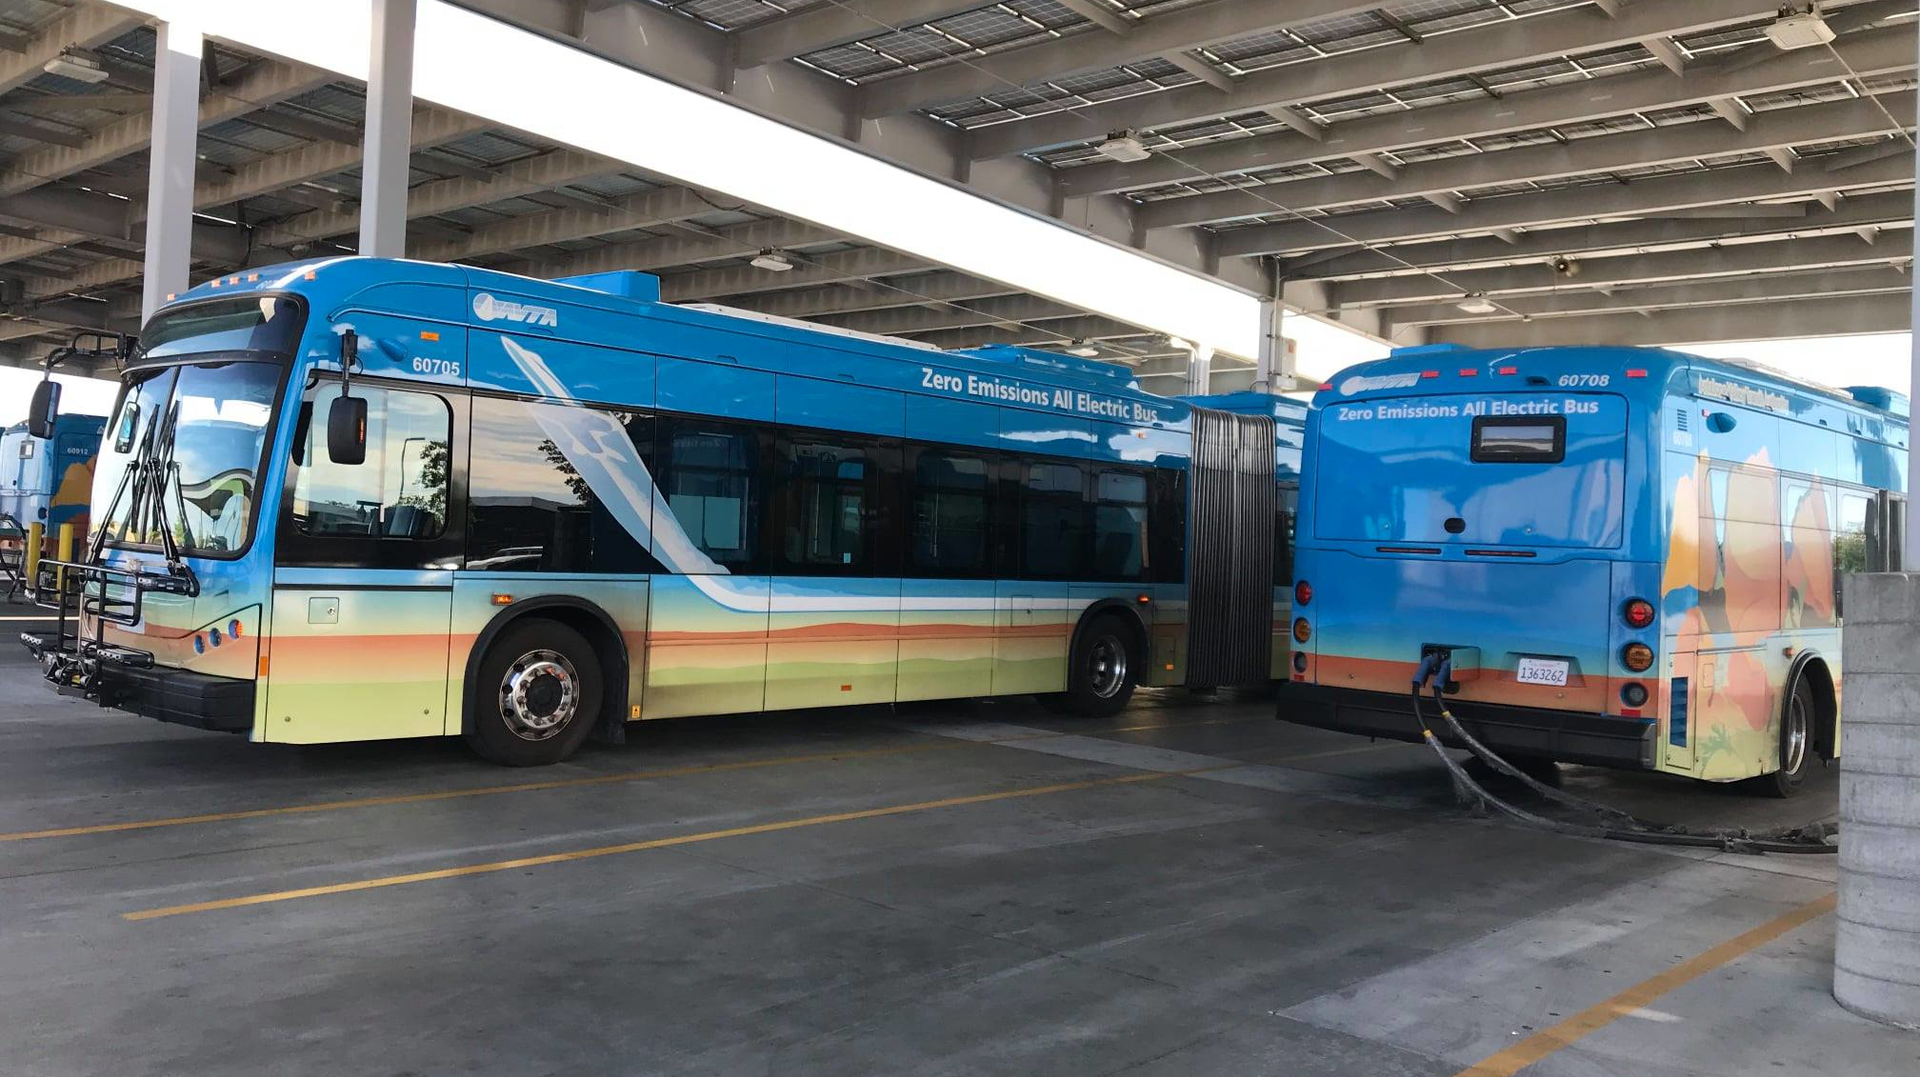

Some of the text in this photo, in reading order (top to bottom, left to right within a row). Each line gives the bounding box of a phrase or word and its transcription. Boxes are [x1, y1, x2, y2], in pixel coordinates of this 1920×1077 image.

[412, 357, 460, 376] 60705
[1557, 374, 1610, 387] 60708
[922, 367, 1159, 422] Zero Emissions All Electric Bus
[1338, 399, 1600, 421] Zero Emissions All Electric Bus
[1521, 667, 1564, 681] 1363262
